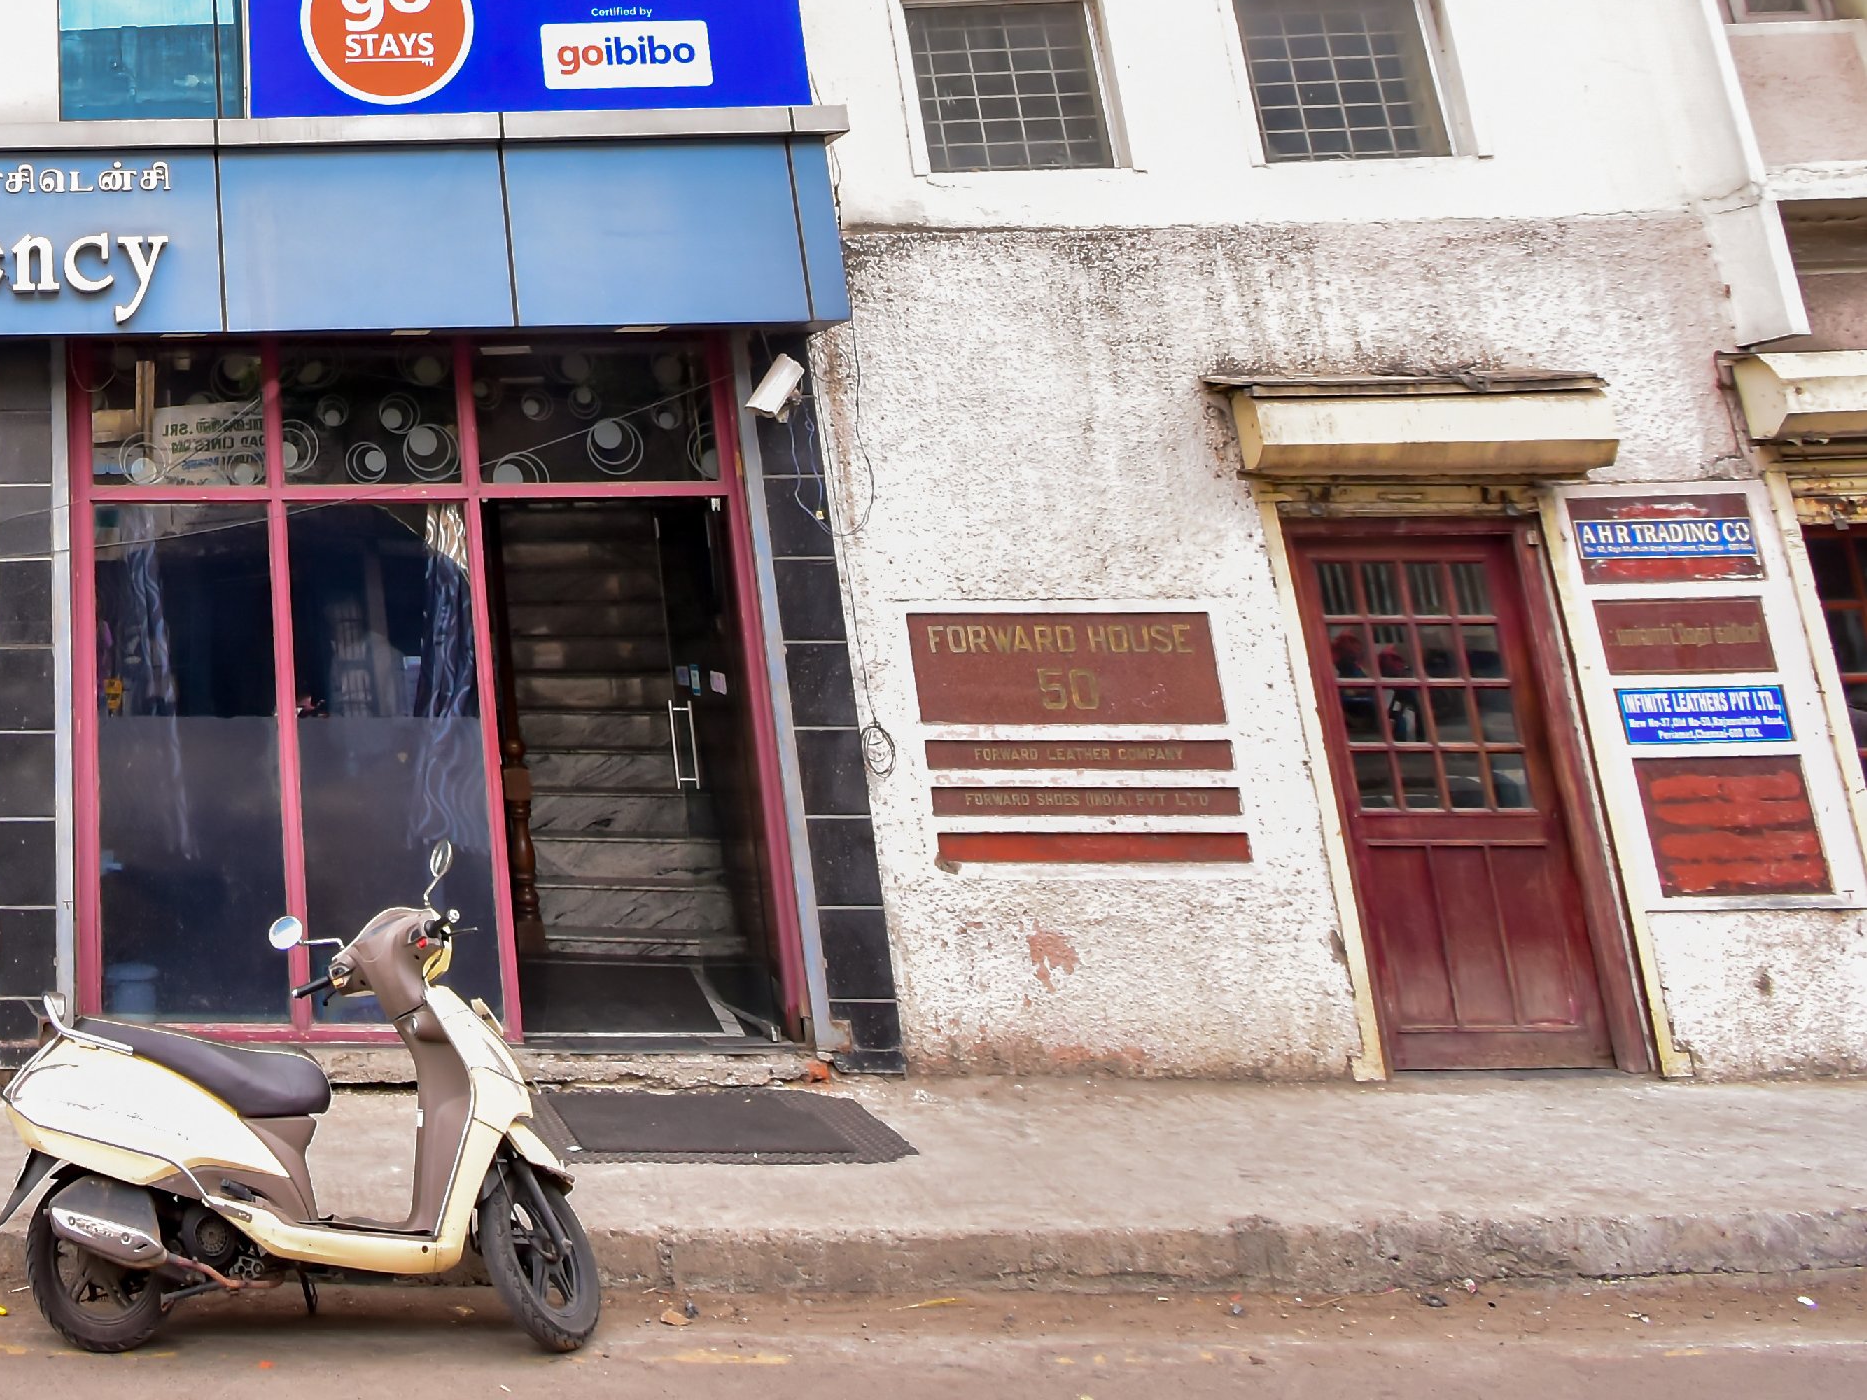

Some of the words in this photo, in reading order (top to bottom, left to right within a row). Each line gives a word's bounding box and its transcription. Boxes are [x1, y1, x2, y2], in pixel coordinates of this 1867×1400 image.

[590, 7, 637, 17] Certified
[639, 6, 653, 18] by
[344, 32, 434, 57] STAYS
[556, 34, 696, 75] goibibo
[1583, 524, 1596, 544] A
[1599, 524, 1614, 544] H
[1615, 523, 1631, 544] R
[1631, 522, 1719, 543] TRADING
[1721, 521, 1751, 542] CO
[926, 624, 1076, 654] FORWARD
[1087, 624, 1194, 654] HOUSE
[1036, 668, 1101, 711] 50
[1622, 693, 1672, 713] INFINITE
[1671, 692, 1729, 713] LEATHERS
[1728, 691, 1752, 711] PVT
[973, 748, 1039, 761] FORWARD
[1048, 748, 1111, 761] LEATHER
[1118, 747, 1184, 761] COMPANY
[965, 793, 1031, 806] FORWARD
[1036, 793, 1080, 806] SHOES
[1135, 793, 1167, 806] PVT
